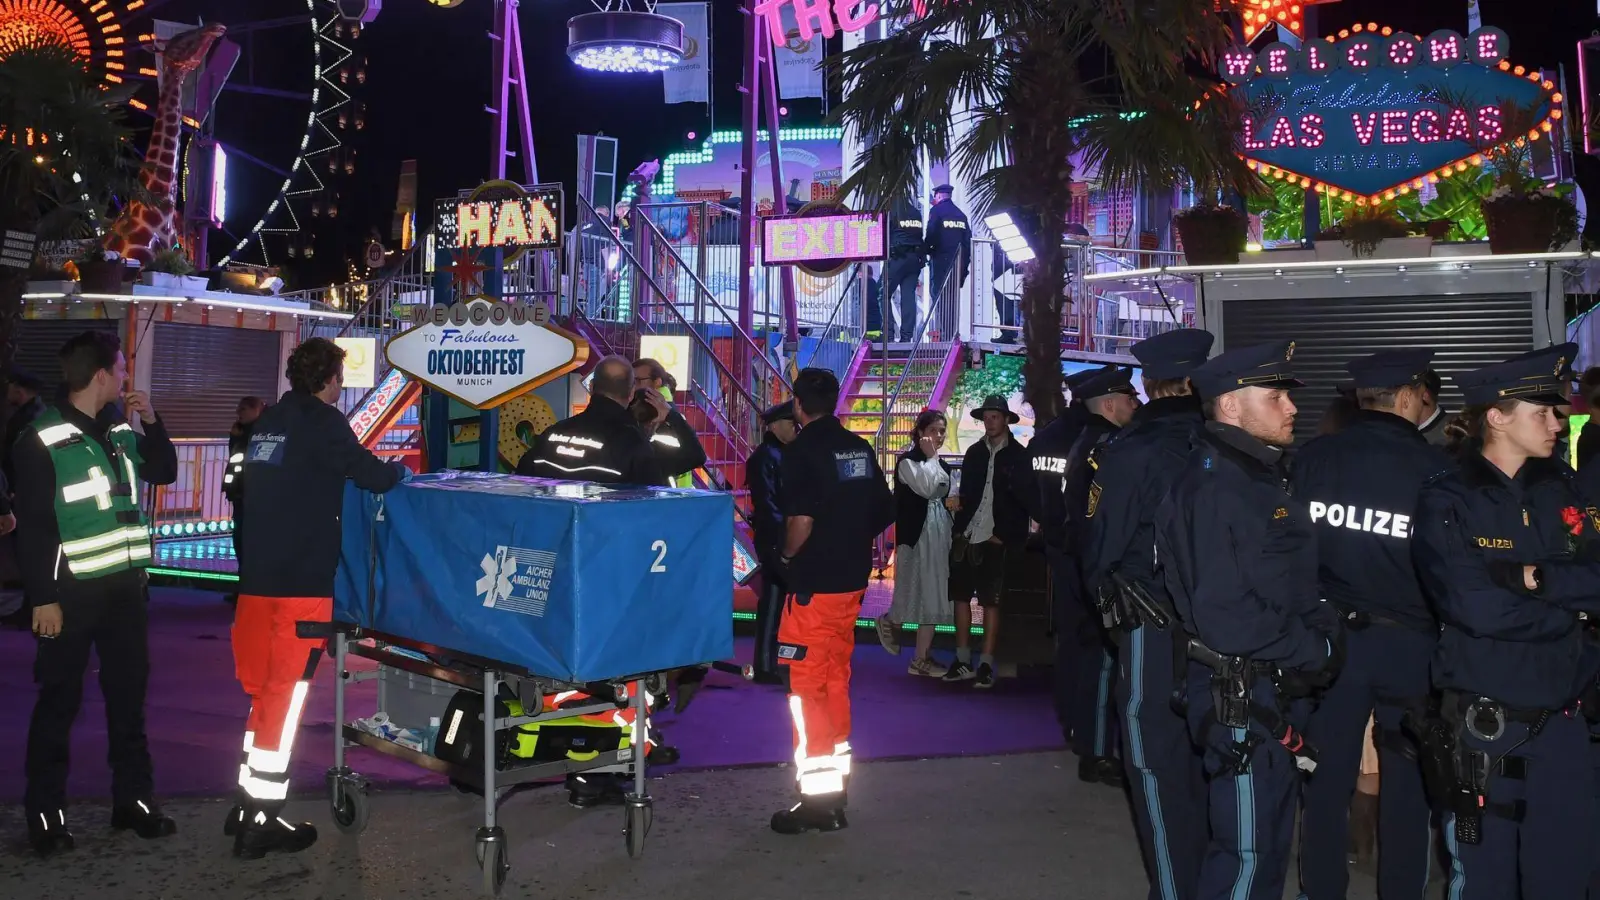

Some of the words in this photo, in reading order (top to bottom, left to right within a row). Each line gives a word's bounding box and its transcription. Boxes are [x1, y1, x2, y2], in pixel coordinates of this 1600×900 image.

[754, 0, 878, 48] THE
[1224, 33, 1498, 76] WELCOME
[1258, 93, 1287, 111] TO
[1292, 82, 1441, 116] Fabulous
[1241, 113, 1326, 151] LAS
[1350, 104, 1502, 146] VEGAS
[1313, 151, 1422, 172] NEVADA
[457, 199, 556, 248] HAN
[772, 220, 878, 257] EXIT
[413, 306, 545, 323] WELCOME
[424, 334, 436, 343] TO
[439, 329, 520, 346] Fabulous
[427, 348, 526, 376] OKTOBERFEST
[456, 378, 493, 386] MUNICH
[1309, 501, 1414, 539] POLIZE
[650, 539, 667, 573] 2
[1473, 536, 1513, 549] OLIZEI
[510, 575, 551, 590] AMBULANZ
[525, 565, 553, 579] AICHER
[525, 588, 549, 601] UNION
